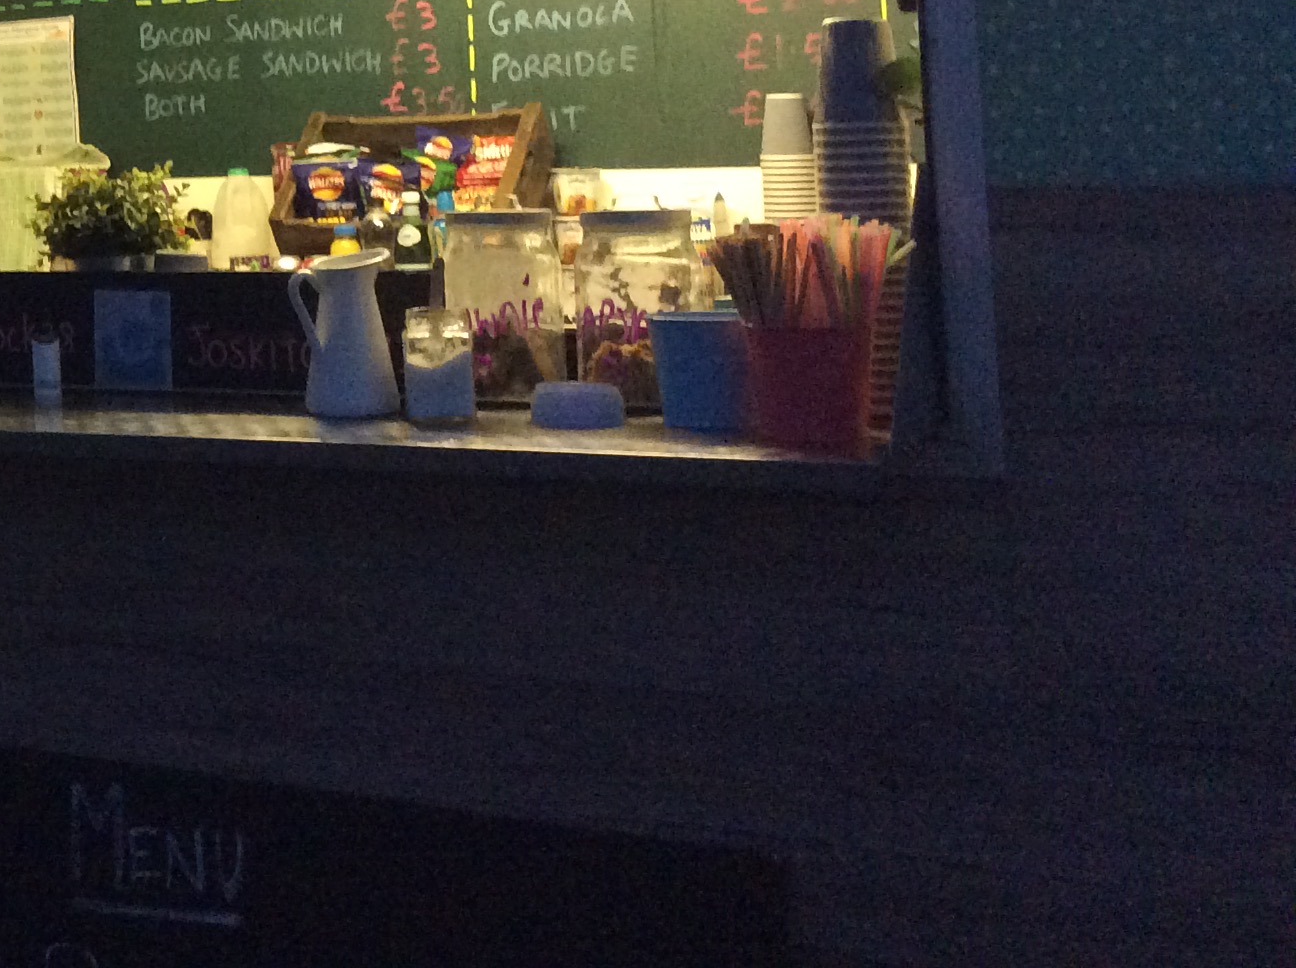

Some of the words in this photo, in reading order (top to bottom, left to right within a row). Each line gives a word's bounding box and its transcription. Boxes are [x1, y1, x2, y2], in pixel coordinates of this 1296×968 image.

[139, 21, 212, 51] BACON
[225, 13, 344, 42] SANDWICH
[136, 55, 241, 84] SAUSAGE
[261, 47, 382, 80] SANDWICH
[491, 45, 639, 84] PORRIDGE
[145, 93, 207, 122] BOTH
[70, 781, 245, 903] MENU
